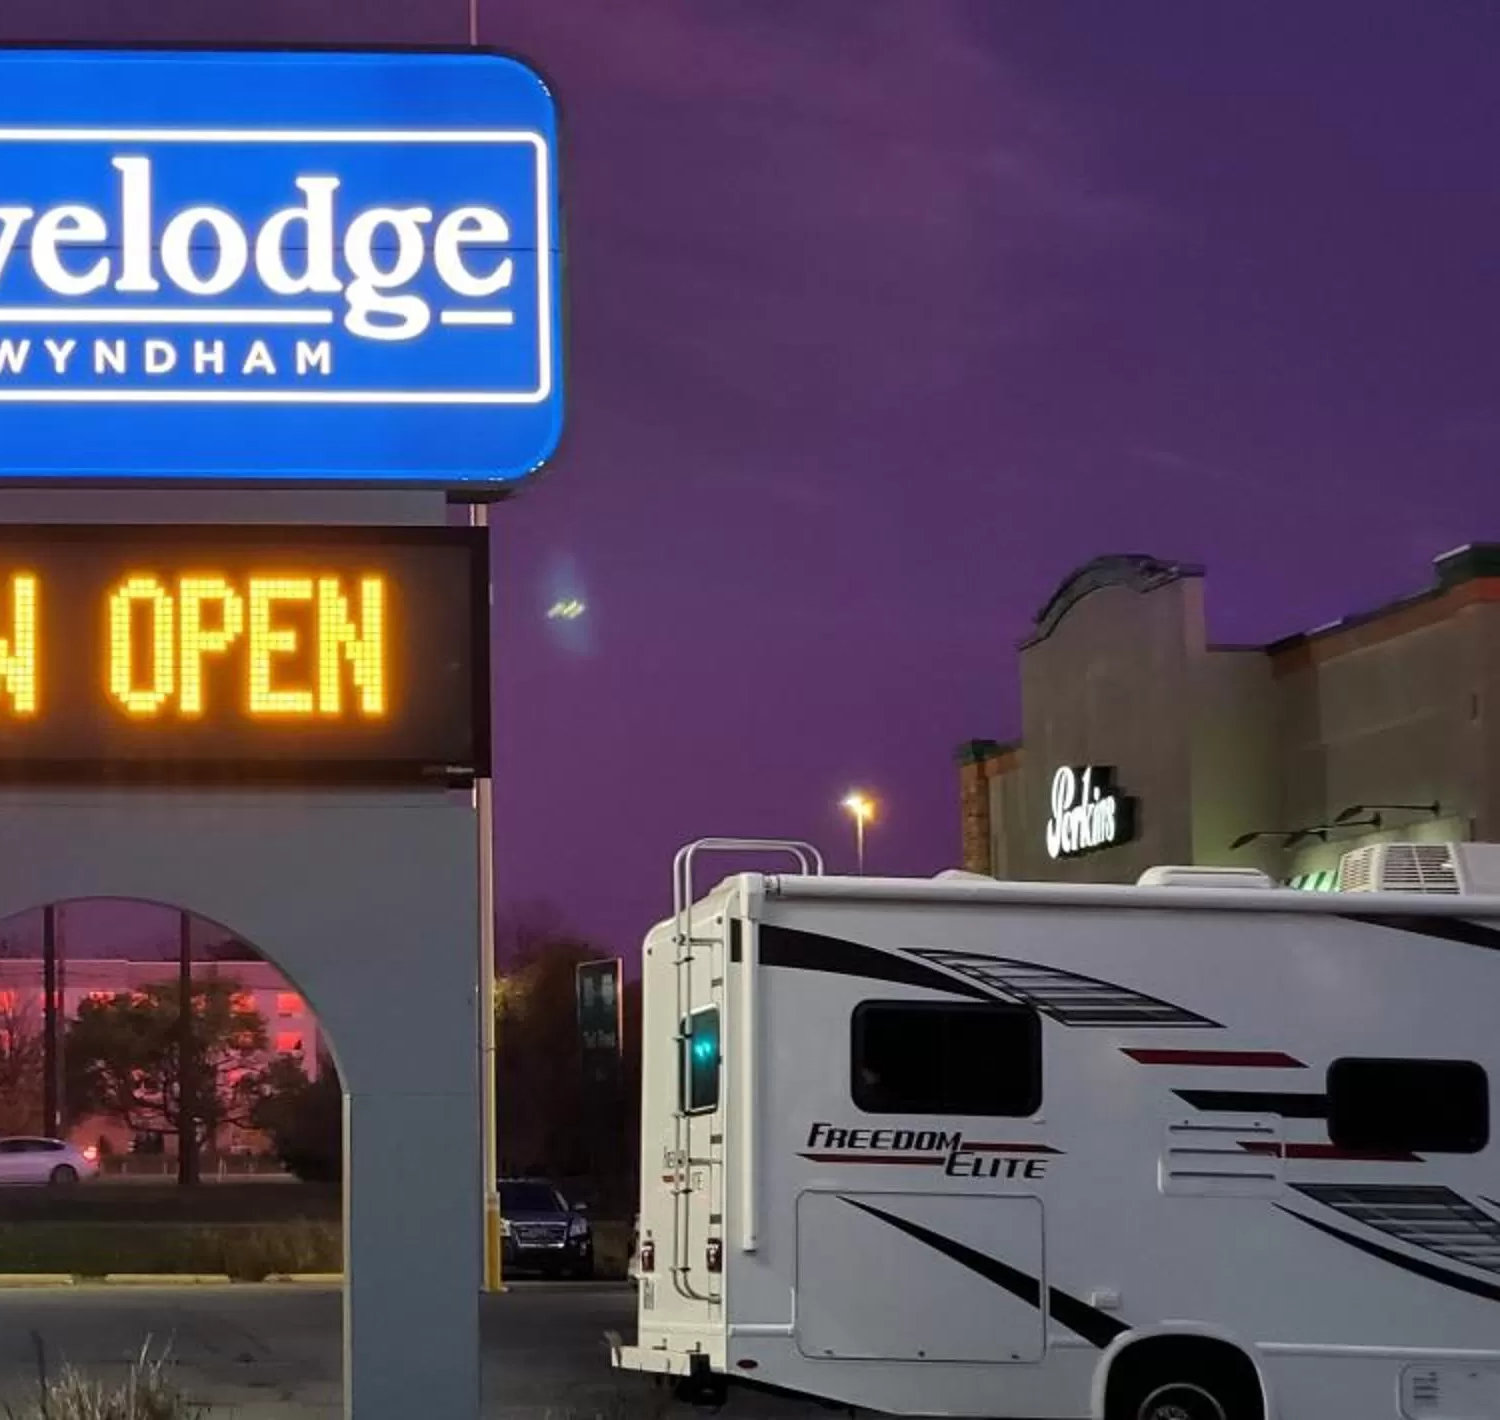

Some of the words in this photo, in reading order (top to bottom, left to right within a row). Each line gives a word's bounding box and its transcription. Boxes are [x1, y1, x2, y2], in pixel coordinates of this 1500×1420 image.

[110, 578, 385, 714] OPEN
[1046, 764, 1117, 860] Perkins
[807, 1123, 963, 1151] FREEDOM
[945, 1151, 1049, 1179] ELITE
